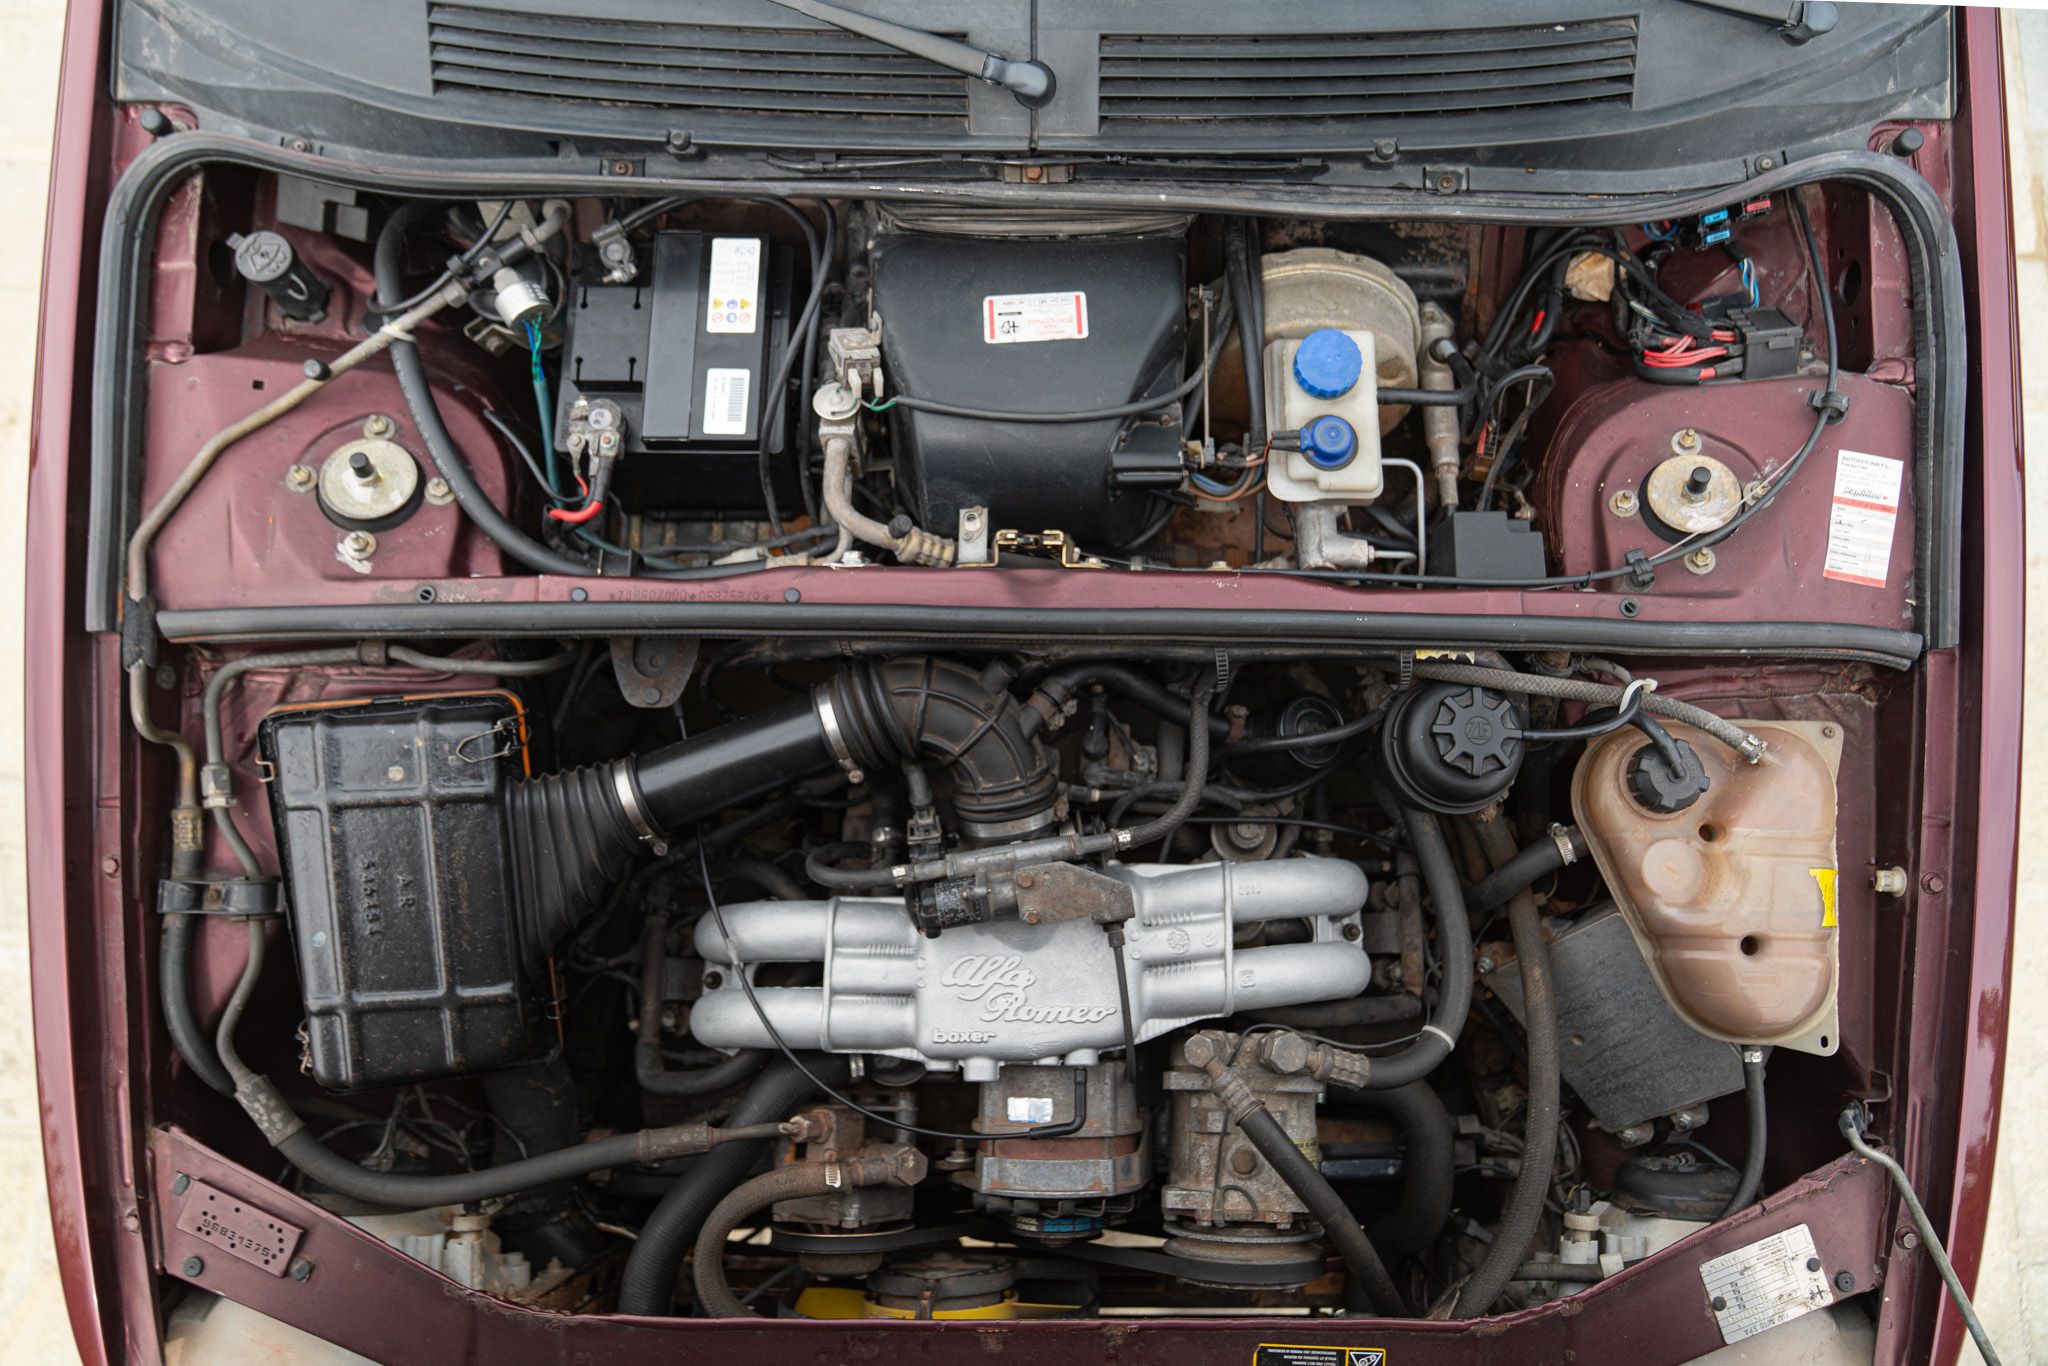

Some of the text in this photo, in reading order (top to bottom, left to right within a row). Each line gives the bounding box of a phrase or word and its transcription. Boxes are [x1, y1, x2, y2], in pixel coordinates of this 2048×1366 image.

[941, 954, 1036, 1002] Alfa
[978, 990, 1117, 1025] Romeo
[932, 1028, 997, 1045] boxer
[202, 1218, 271, 1257] 96831375
